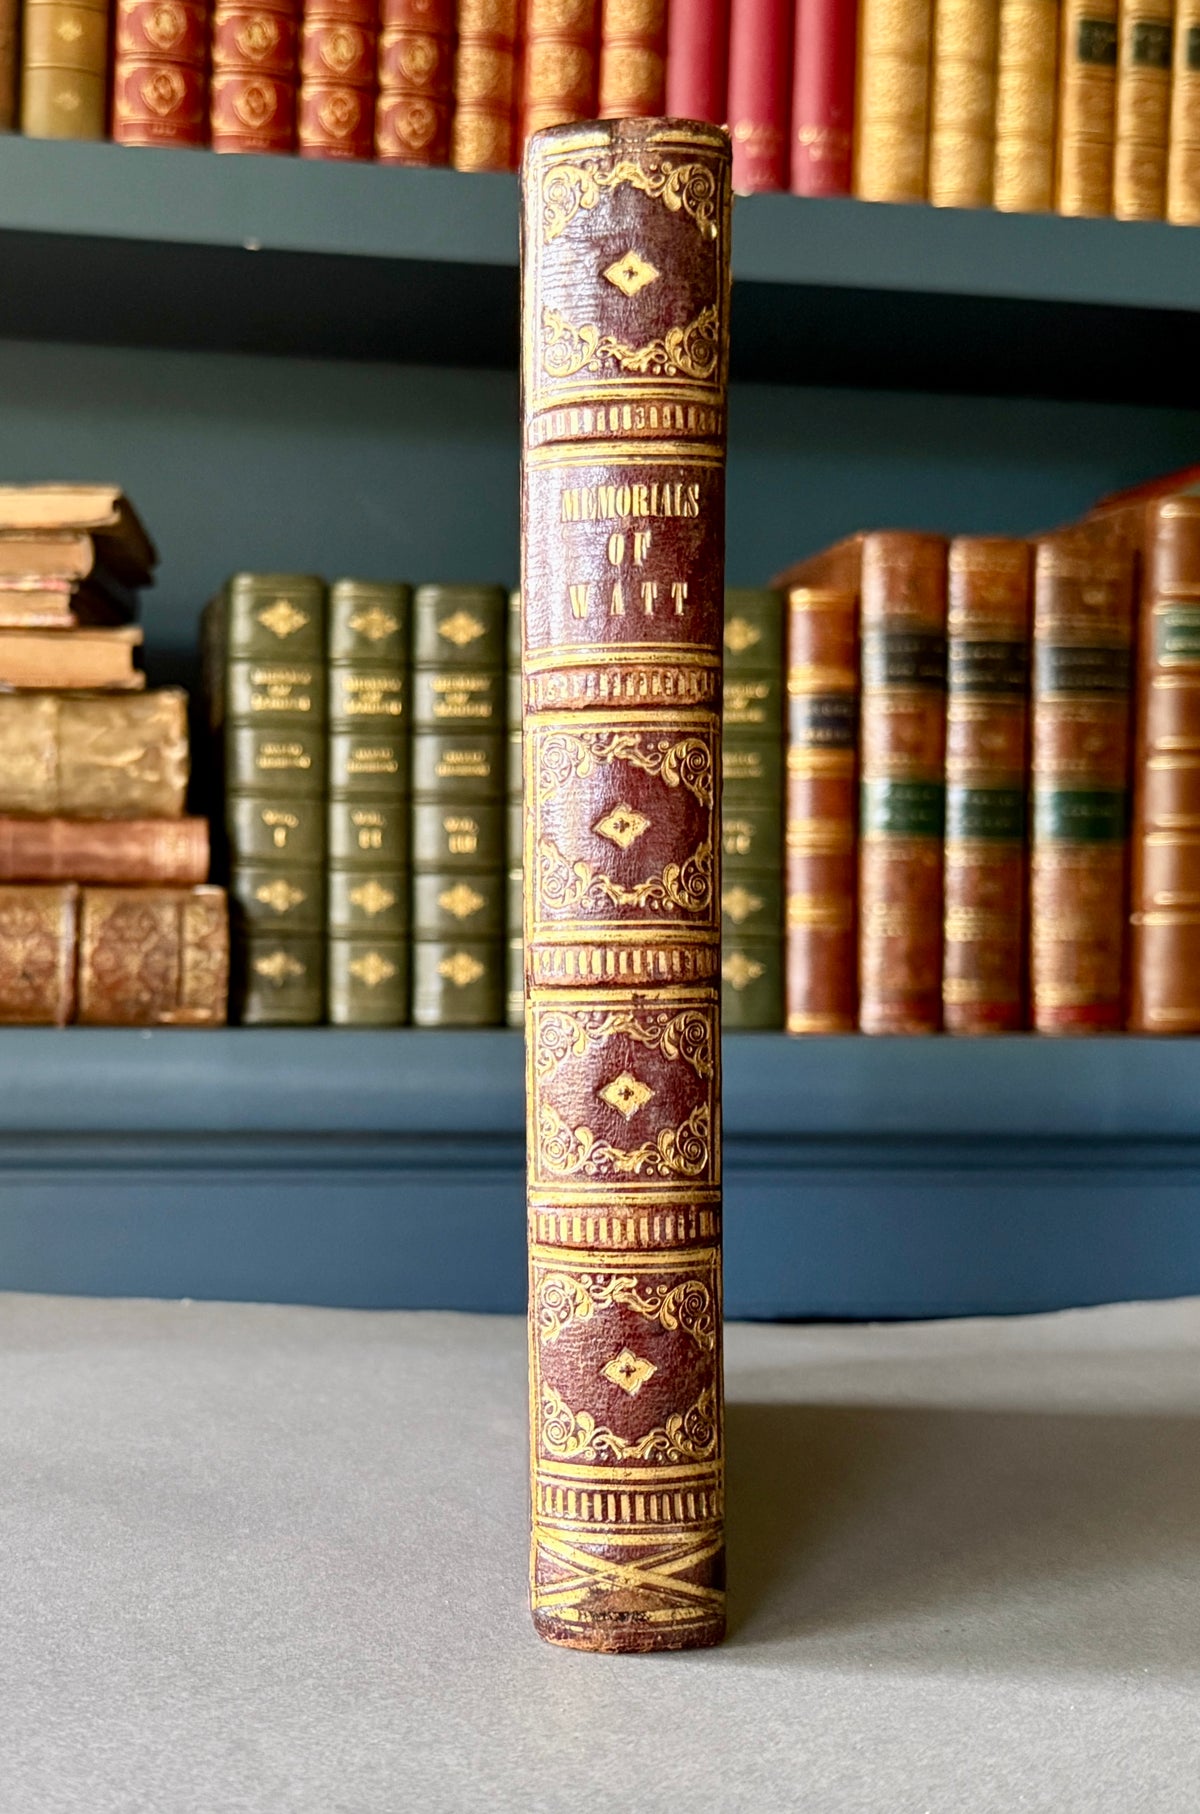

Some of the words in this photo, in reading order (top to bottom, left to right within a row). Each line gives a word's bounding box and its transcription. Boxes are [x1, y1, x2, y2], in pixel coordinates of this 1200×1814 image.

[561, 483, 699, 523] MEMORIALS
[608, 530, 651, 566] OF
[569, 578, 688, 619] WATT
